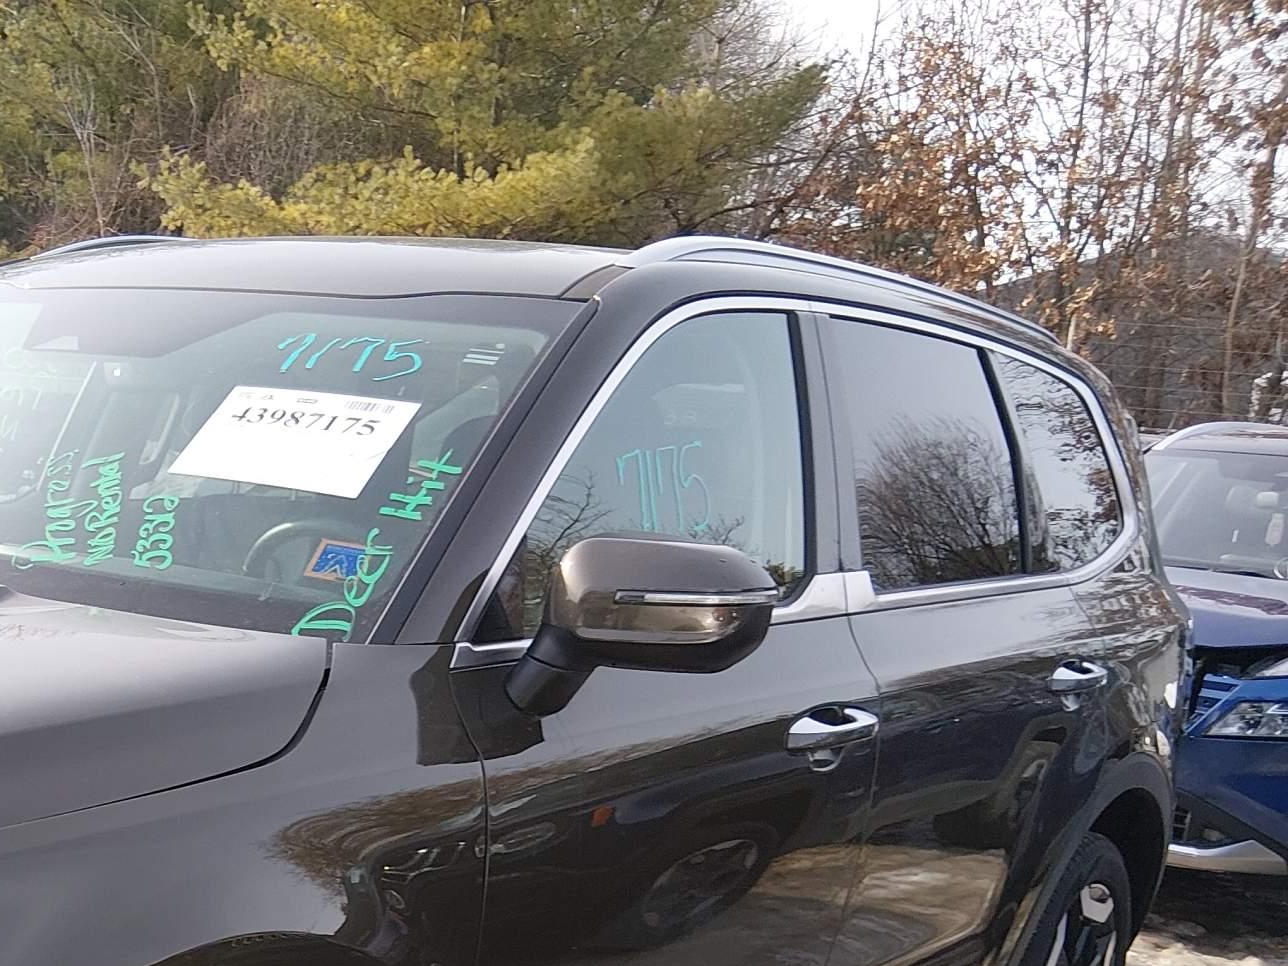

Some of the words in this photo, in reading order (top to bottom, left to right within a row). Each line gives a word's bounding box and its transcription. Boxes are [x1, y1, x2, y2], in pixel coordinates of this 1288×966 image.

[278, 333, 428, 381] 7175
[231, 406, 381, 436] 43987175
[615, 440, 711, 534] 7175
[291, 528, 394, 642] Deer
[379, 449, 463, 520] Hit
